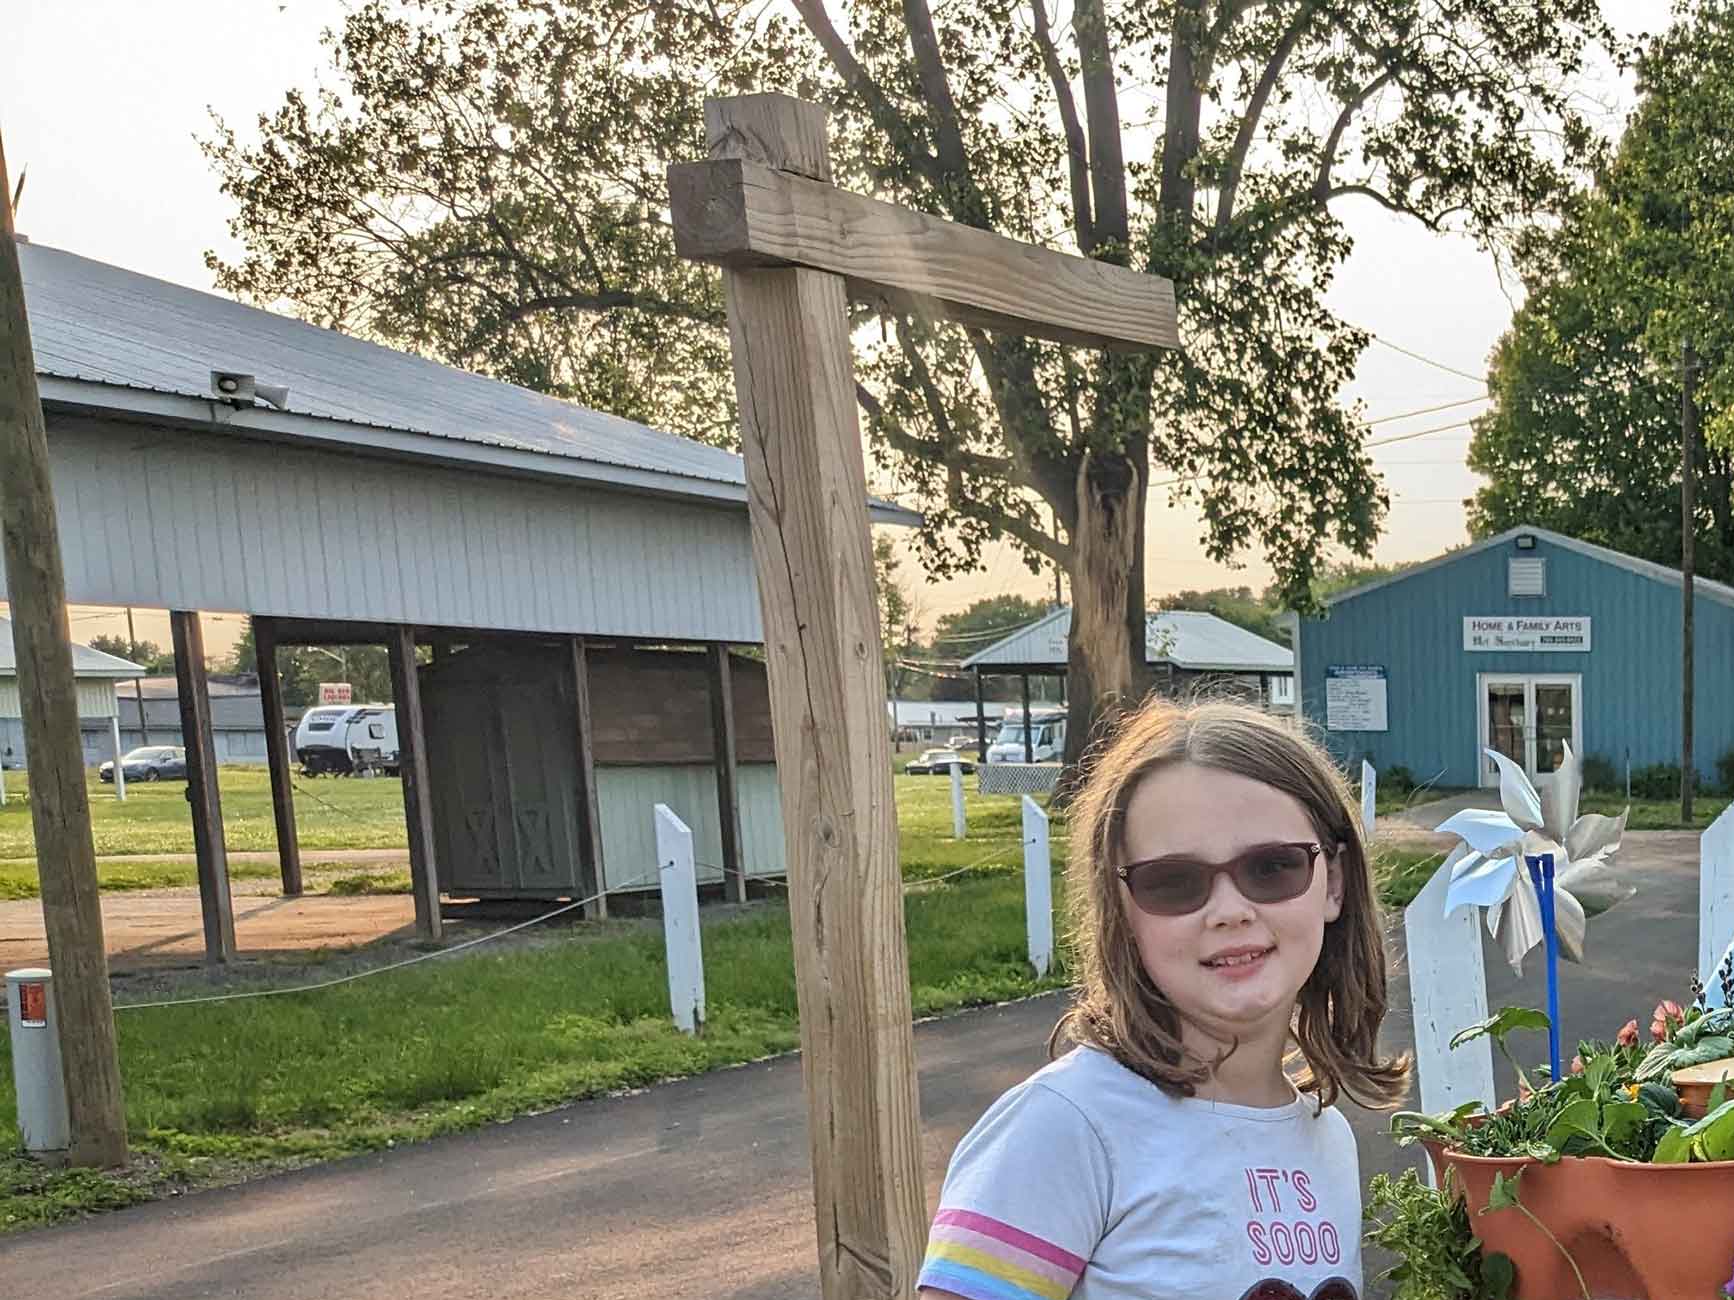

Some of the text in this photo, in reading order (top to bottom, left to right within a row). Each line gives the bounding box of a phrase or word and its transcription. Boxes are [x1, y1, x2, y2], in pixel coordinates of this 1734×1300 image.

[1472, 620, 1504, 632] HOME
[1517, 620, 1550, 632] FAMILY
[1554, 620, 1583, 632] ARTS
[1244, 1167, 1317, 1213] IT'S
[1246, 1220, 1341, 1266] SOOO
